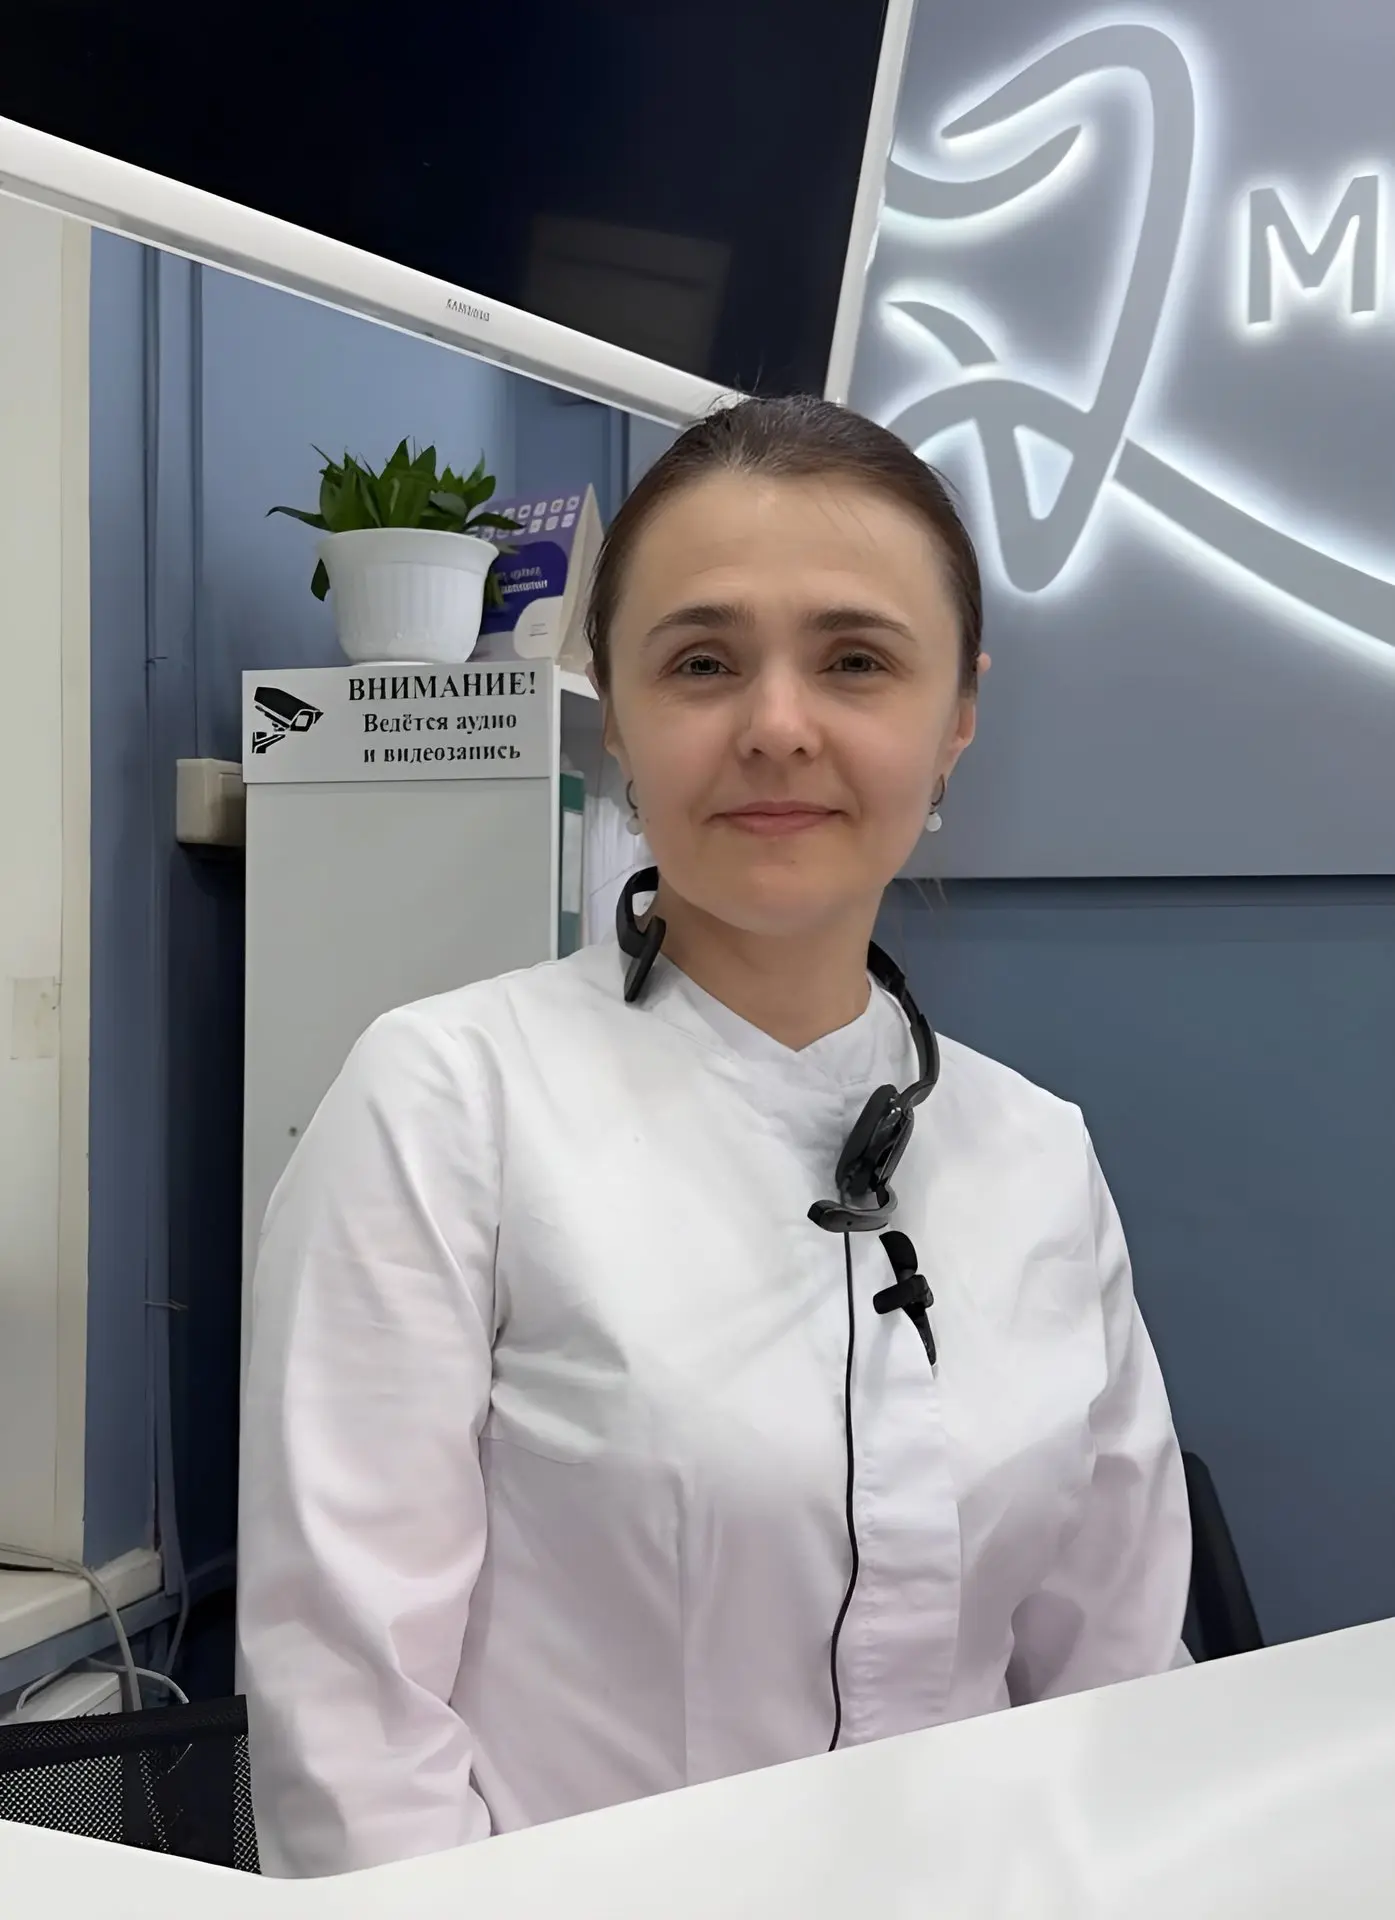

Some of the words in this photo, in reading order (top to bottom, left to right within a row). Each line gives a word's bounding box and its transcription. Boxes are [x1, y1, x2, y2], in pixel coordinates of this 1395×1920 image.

[348, 671, 536, 701] ВНИМАНИЕ!
[363, 713, 448, 733] Ведётся
[456, 713, 517, 735] аудио
[363, 748, 375, 763] и
[384, 745, 521, 764] видеозапись
